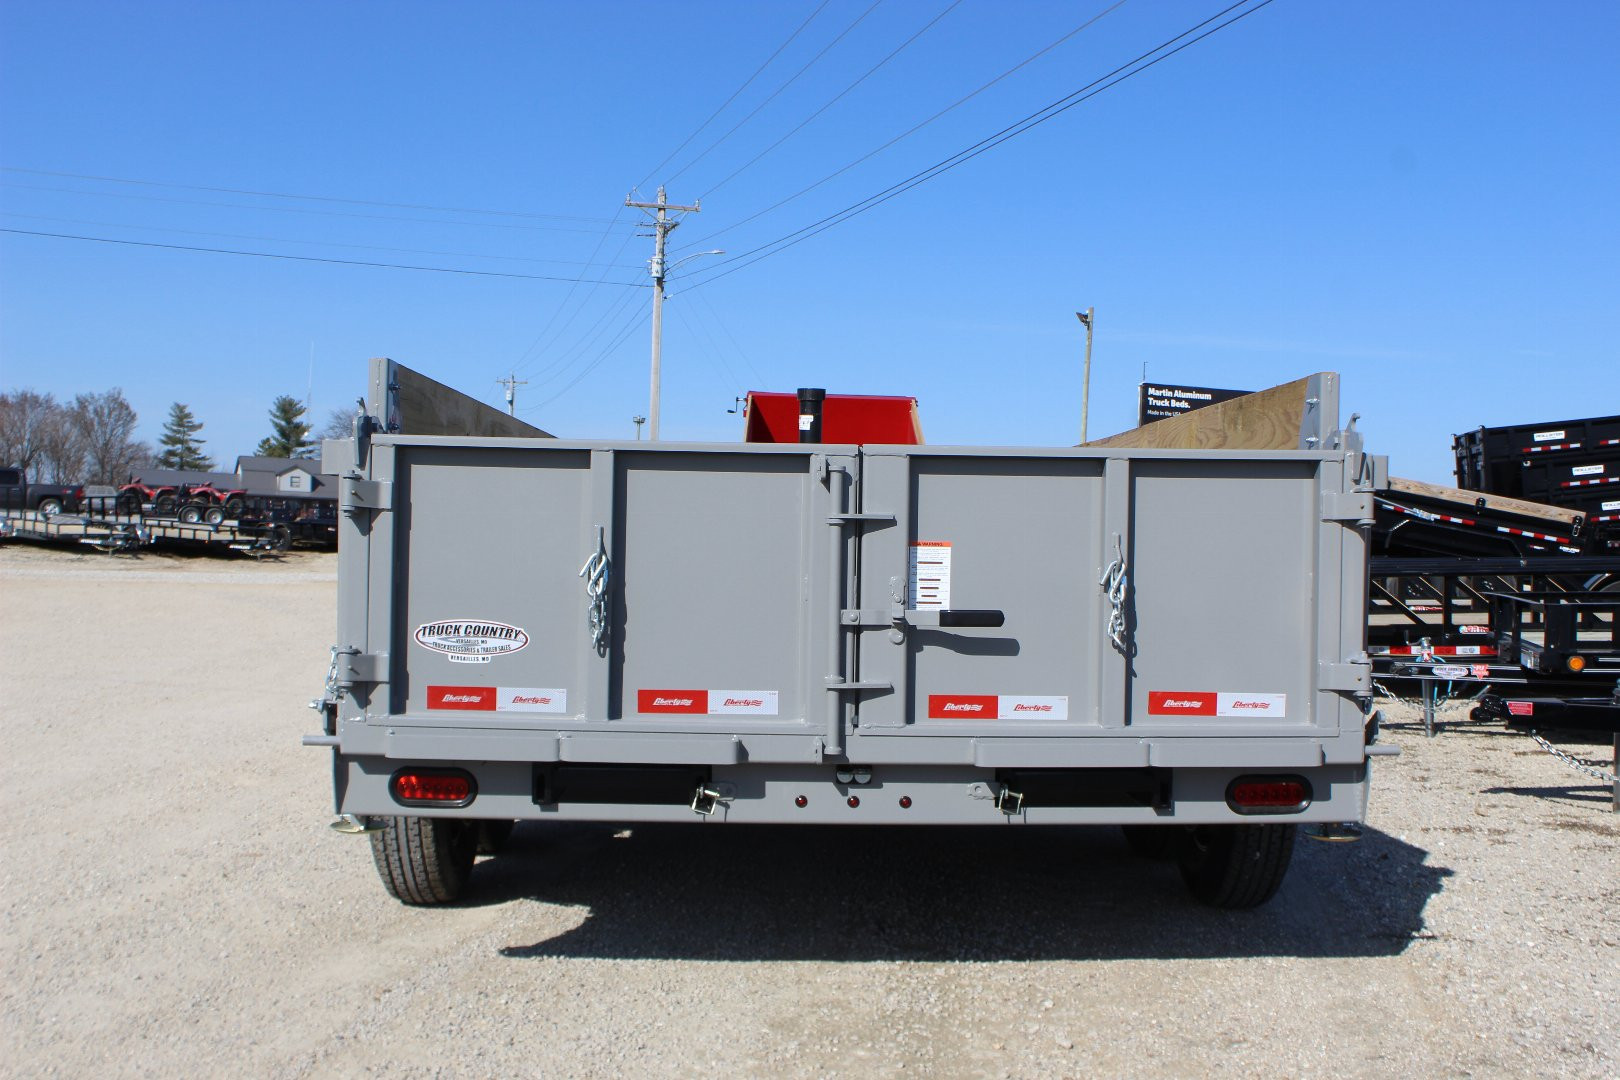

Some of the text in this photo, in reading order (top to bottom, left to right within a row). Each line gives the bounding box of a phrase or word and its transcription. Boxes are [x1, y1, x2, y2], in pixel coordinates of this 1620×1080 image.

[1148, 388, 1212, 400] Martin Aluminum
[1148, 398, 1190, 408] Truck Beds.
[421, 624, 522, 639] TRUCK COUNTRY
[432, 641, 447, 651] TRUCK
[446, 645, 476, 653] ACCESSORIES
[498, 644, 511, 652] SALES
[442, 694, 471, 703] Liberty
[512, 696, 539, 704] Liberty
[652, 697, 682, 706] Liberty
[724, 698, 751, 707] Liberty
[943, 702, 972, 711] Liberty
[1013, 703, 1041, 712] Liberty
[1163, 699, 1191, 708] Liberty
[1232, 700, 1259, 709] Liberty
